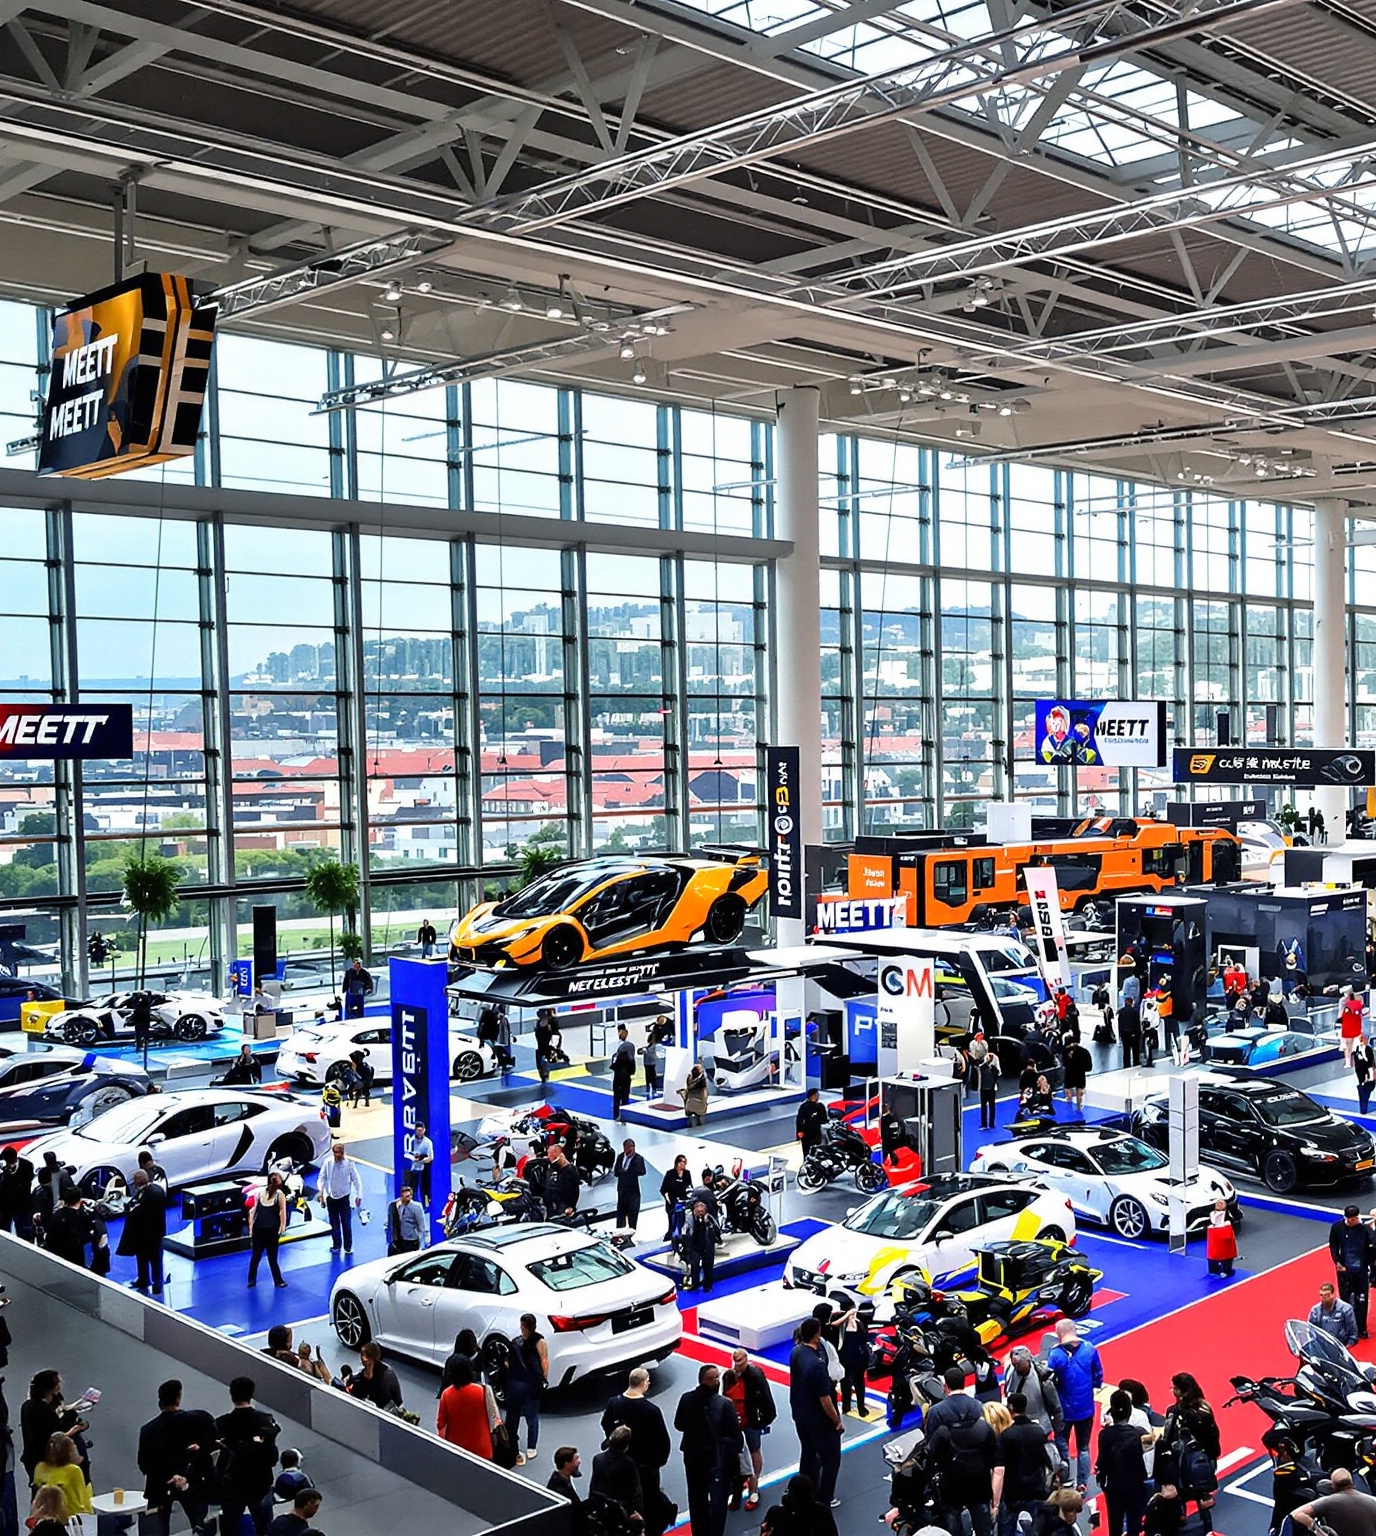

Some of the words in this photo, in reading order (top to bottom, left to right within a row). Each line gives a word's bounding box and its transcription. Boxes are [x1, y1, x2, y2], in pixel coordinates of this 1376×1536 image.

[63, 333, 118, 389] MEETT
[50, 389, 104, 441] MEETT
[817, 899, 898, 929] MEETT
